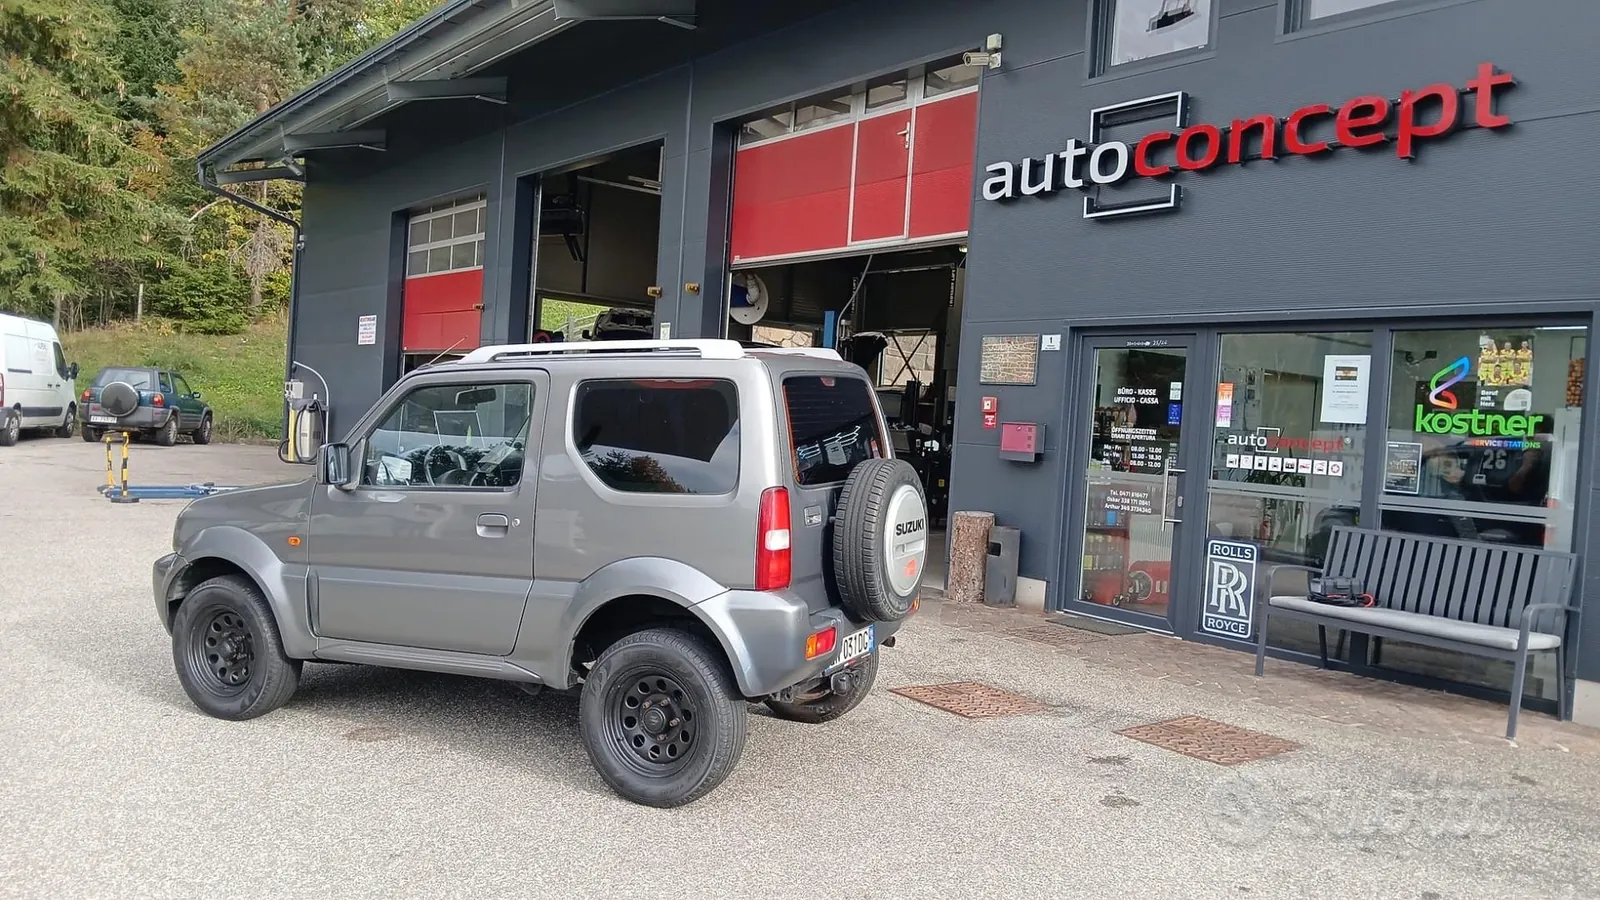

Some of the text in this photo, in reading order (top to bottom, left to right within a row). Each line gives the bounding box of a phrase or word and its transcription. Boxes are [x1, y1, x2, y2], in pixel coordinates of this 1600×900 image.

[981, 62, 1517, 202] autoconcept
[1117, 387, 1156, 396] BÜRO KASSE
[1113, 396, 1159, 405] UFFICIO CASSA
[1415, 404, 1543, 436] kostner
[1503, 440, 1541, 448] STATIONS
[895, 519, 924, 537] SUZUKI
[1212, 544, 1252, 559] ROLLS
[1207, 617, 1246, 634] ROYCE
